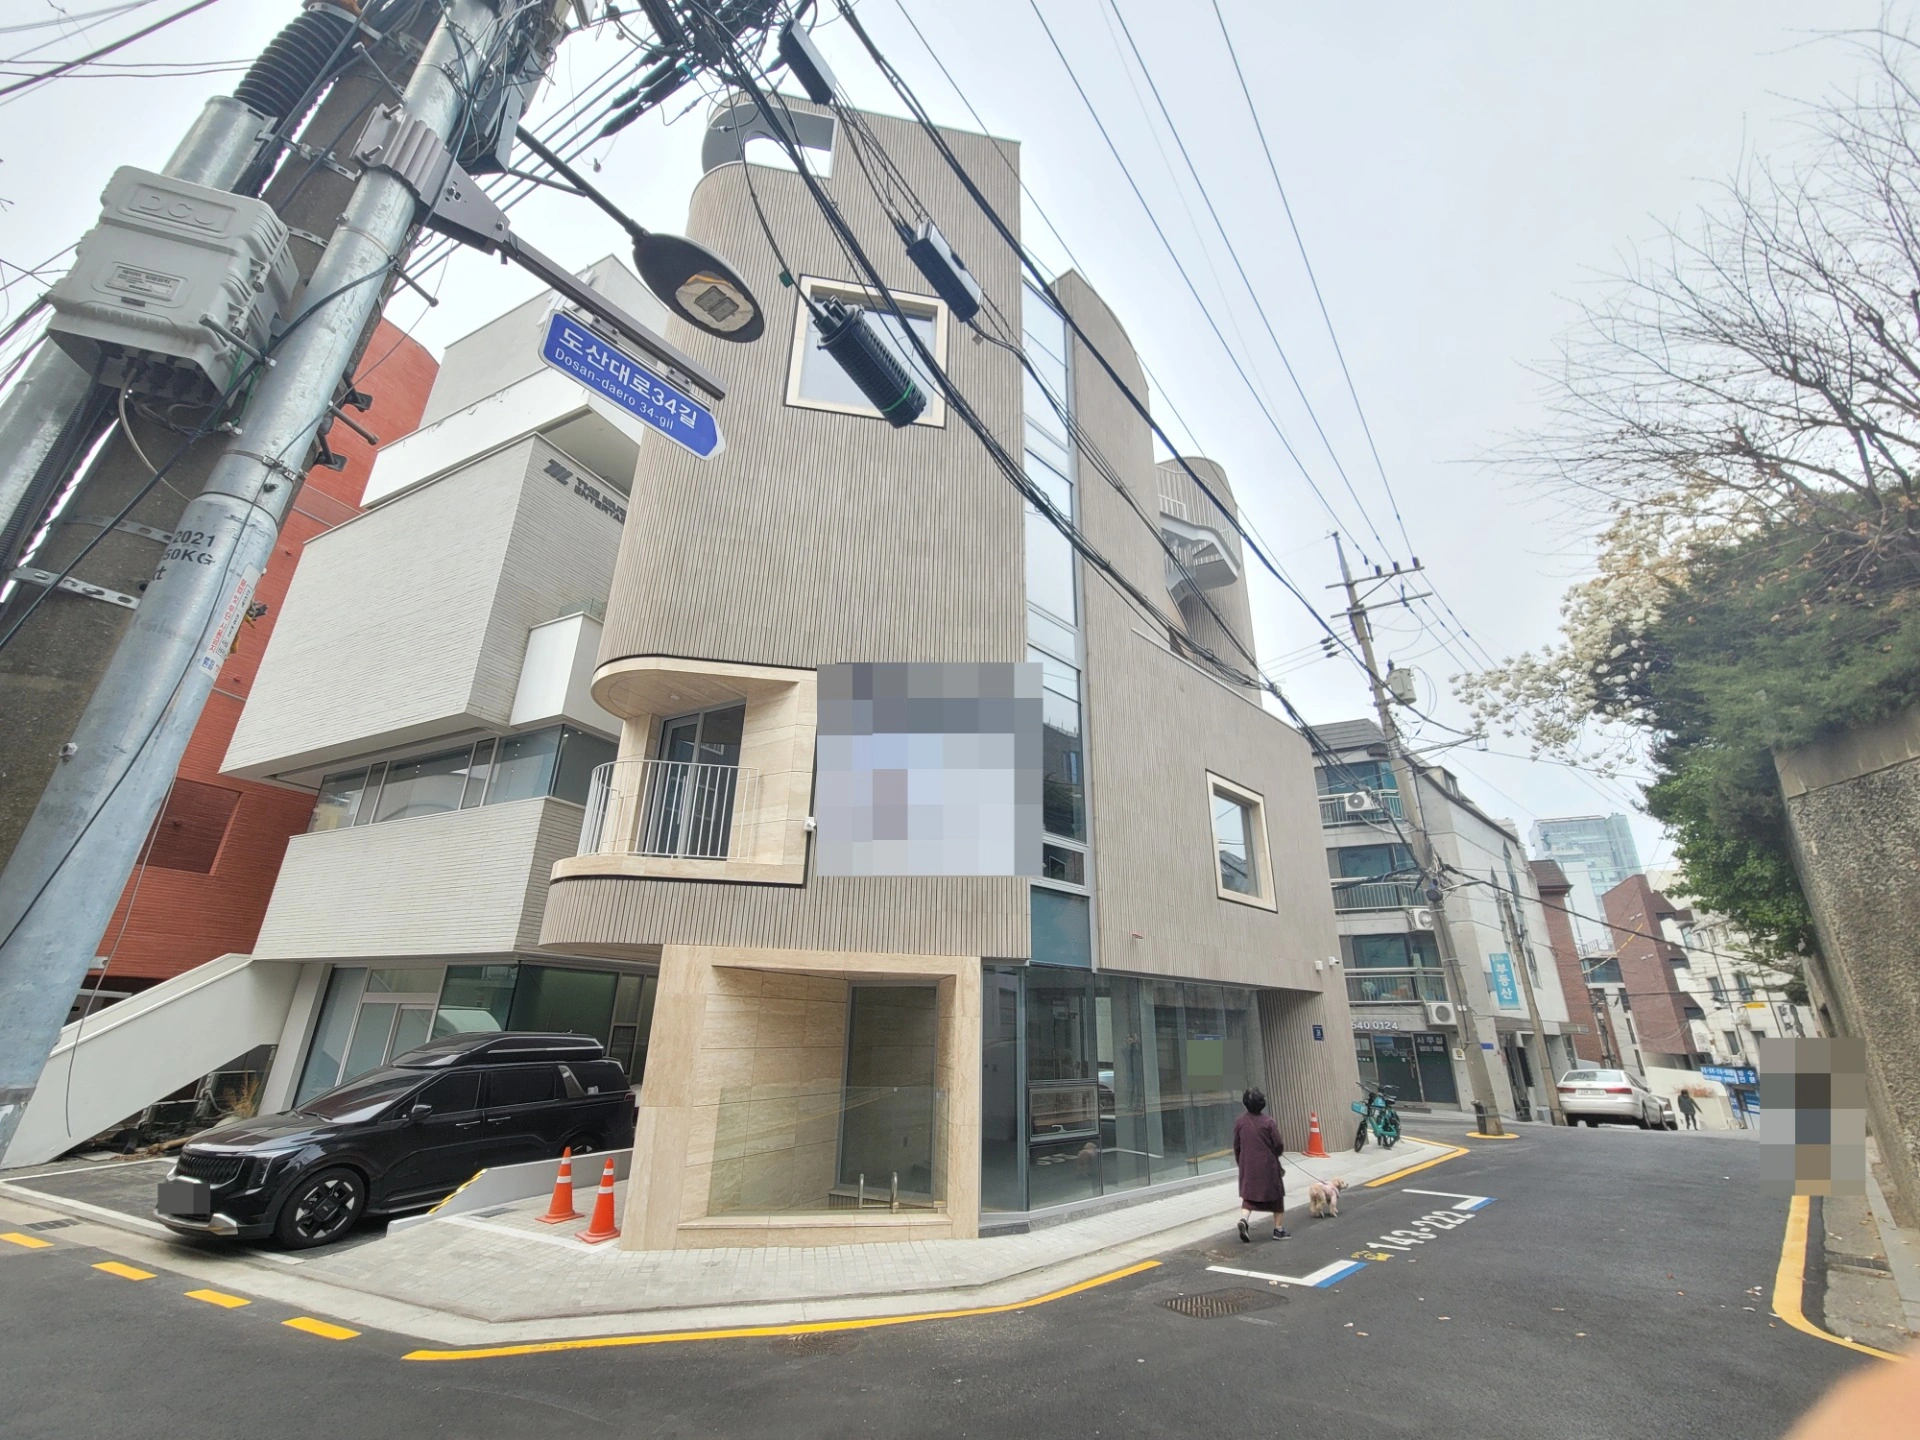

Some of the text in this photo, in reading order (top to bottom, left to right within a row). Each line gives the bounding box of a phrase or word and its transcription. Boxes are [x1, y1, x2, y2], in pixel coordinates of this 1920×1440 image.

[555, 347, 673, 430] Dosan-daero 34-gil
[559, 328, 697, 429] 도산대로34길
[173, 530, 215, 547] 2021
[1495, 963, 1513, 1000] 부동산
